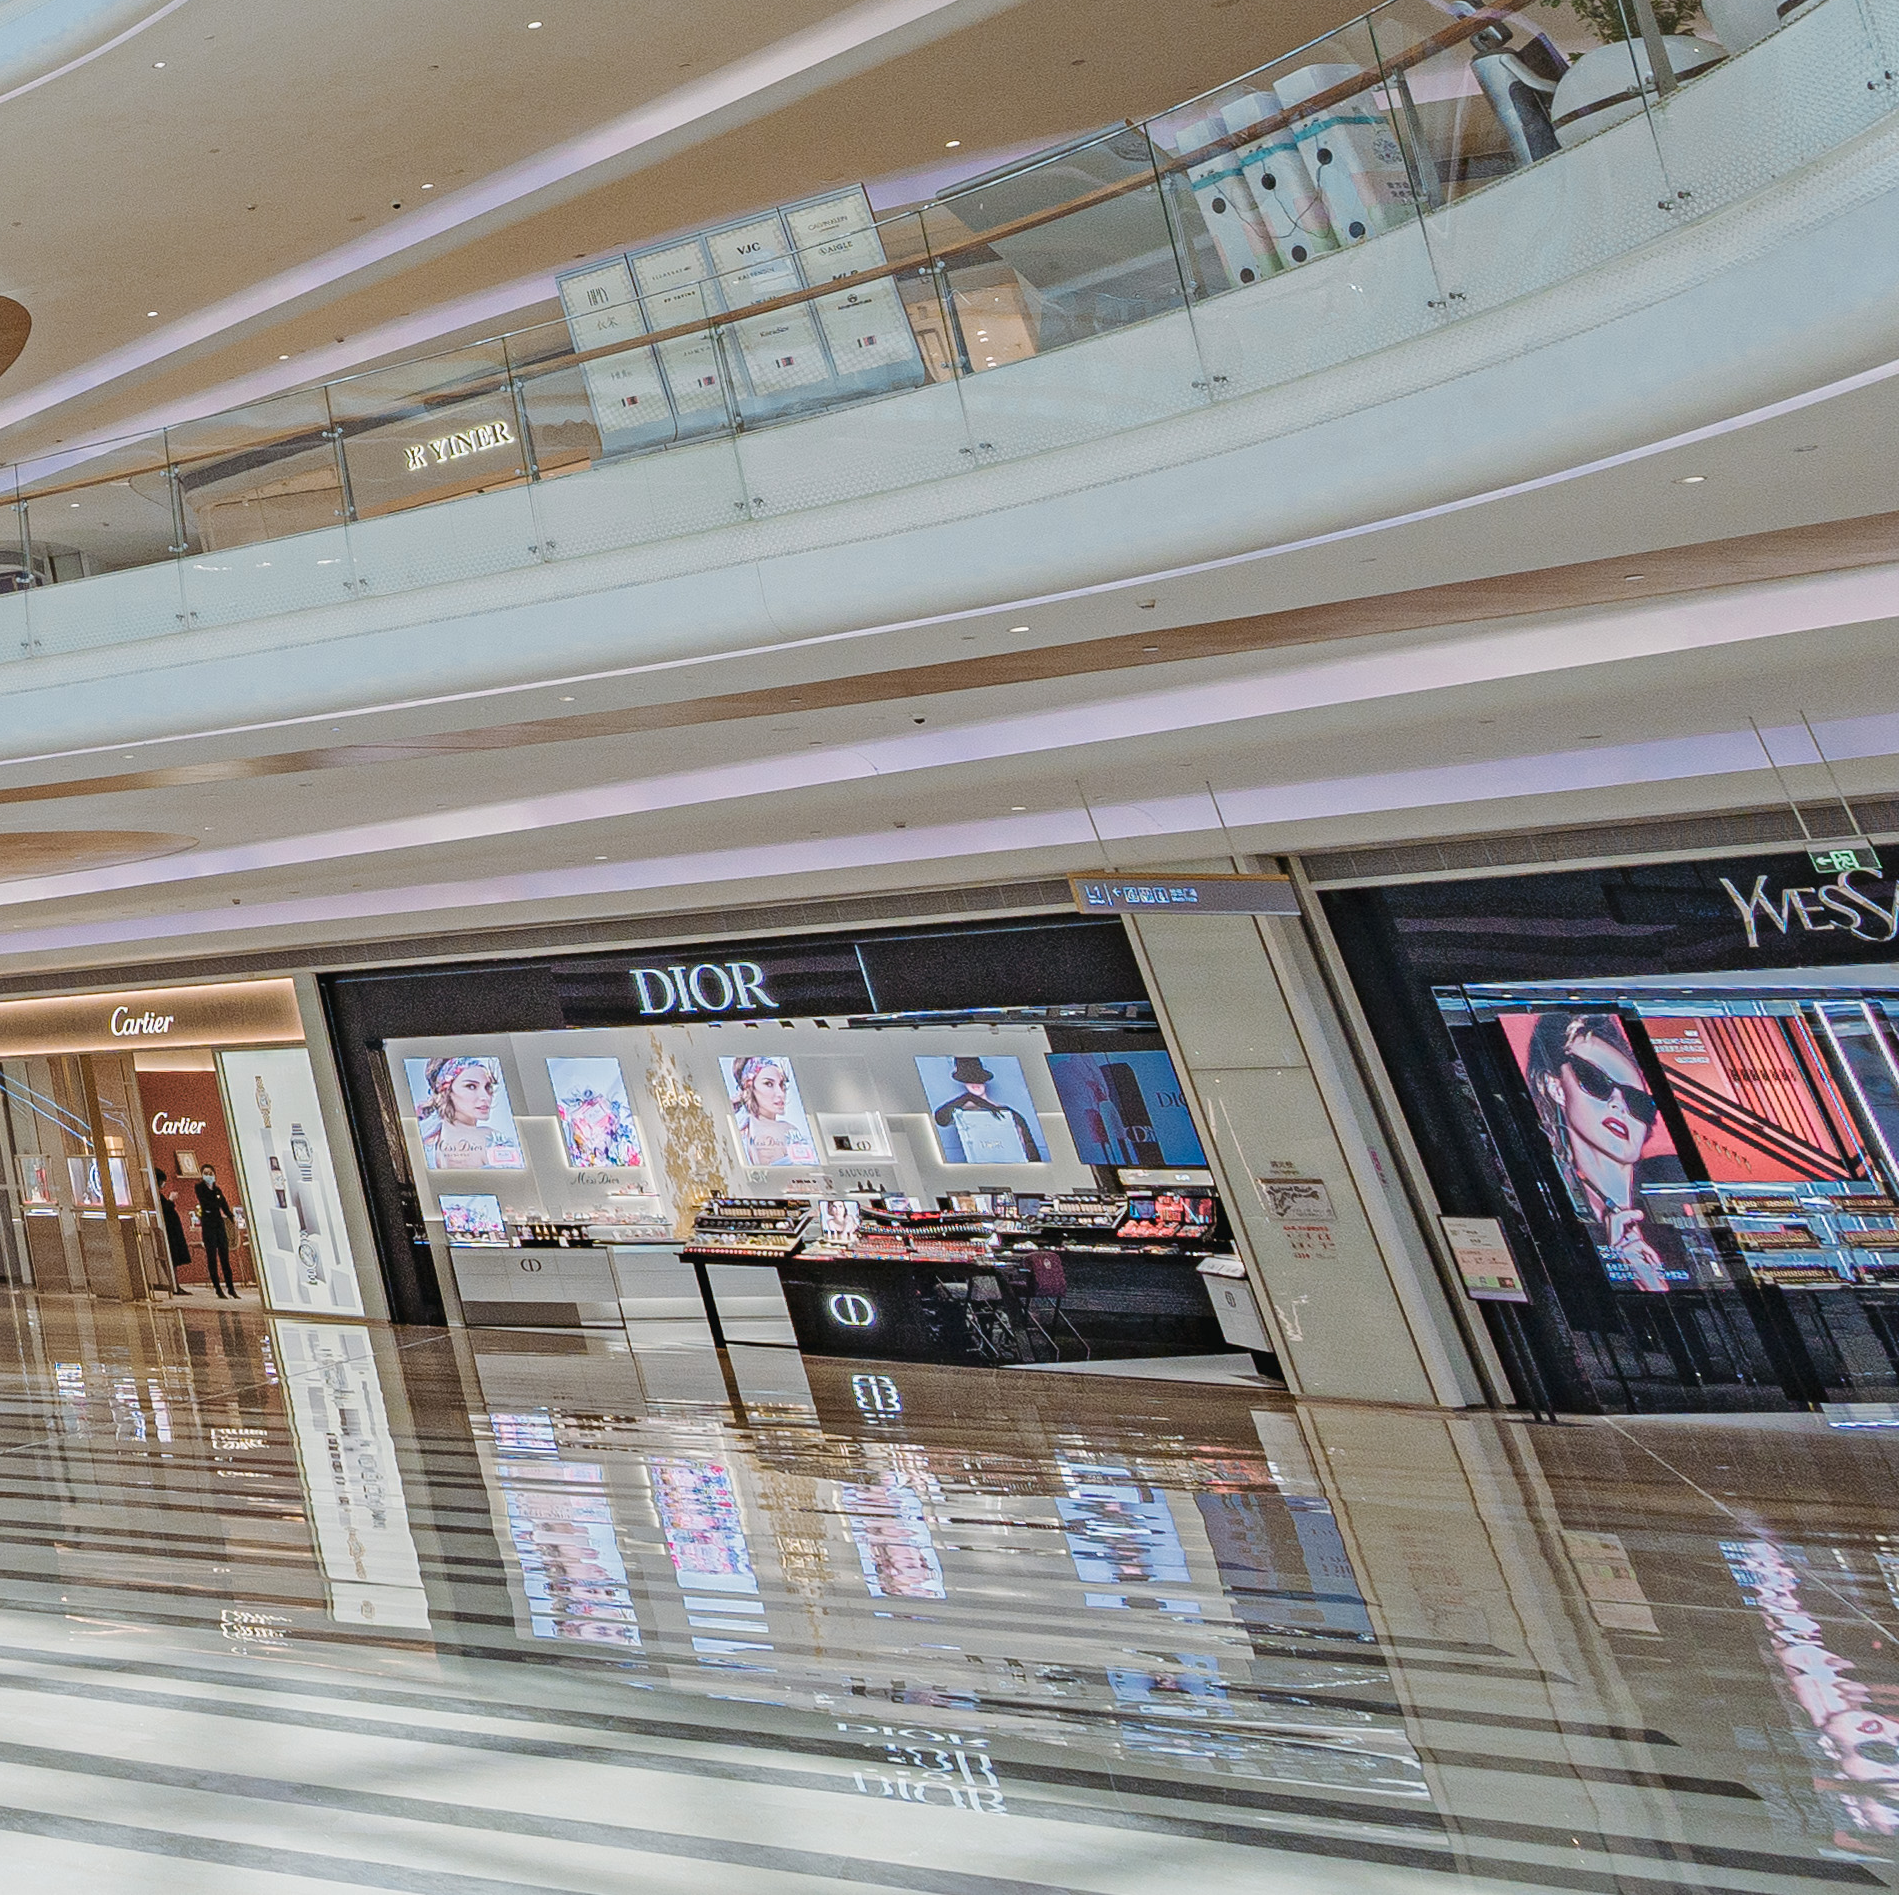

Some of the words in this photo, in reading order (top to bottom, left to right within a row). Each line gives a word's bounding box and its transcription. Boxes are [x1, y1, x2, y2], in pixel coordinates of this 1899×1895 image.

[736, 242, 761, 255] VJC
[827, 240, 854, 255] AIGLE
[427, 421, 514, 463] YINER
[1719, 874, 1861, 948] YVES
[629, 961, 780, 1015] DIOR
[110, 1005, 174, 1037] Cartier
[151, 1111, 206, 1135] Cartier
[427, 1139, 457, 1152] Miss
[460, 1139, 483, 1152] Dior
[571, 1171, 596, 1185] Miss
[597, 1171, 620, 1184] Dior
[838, 1167, 881, 1178] SAUVAGE
